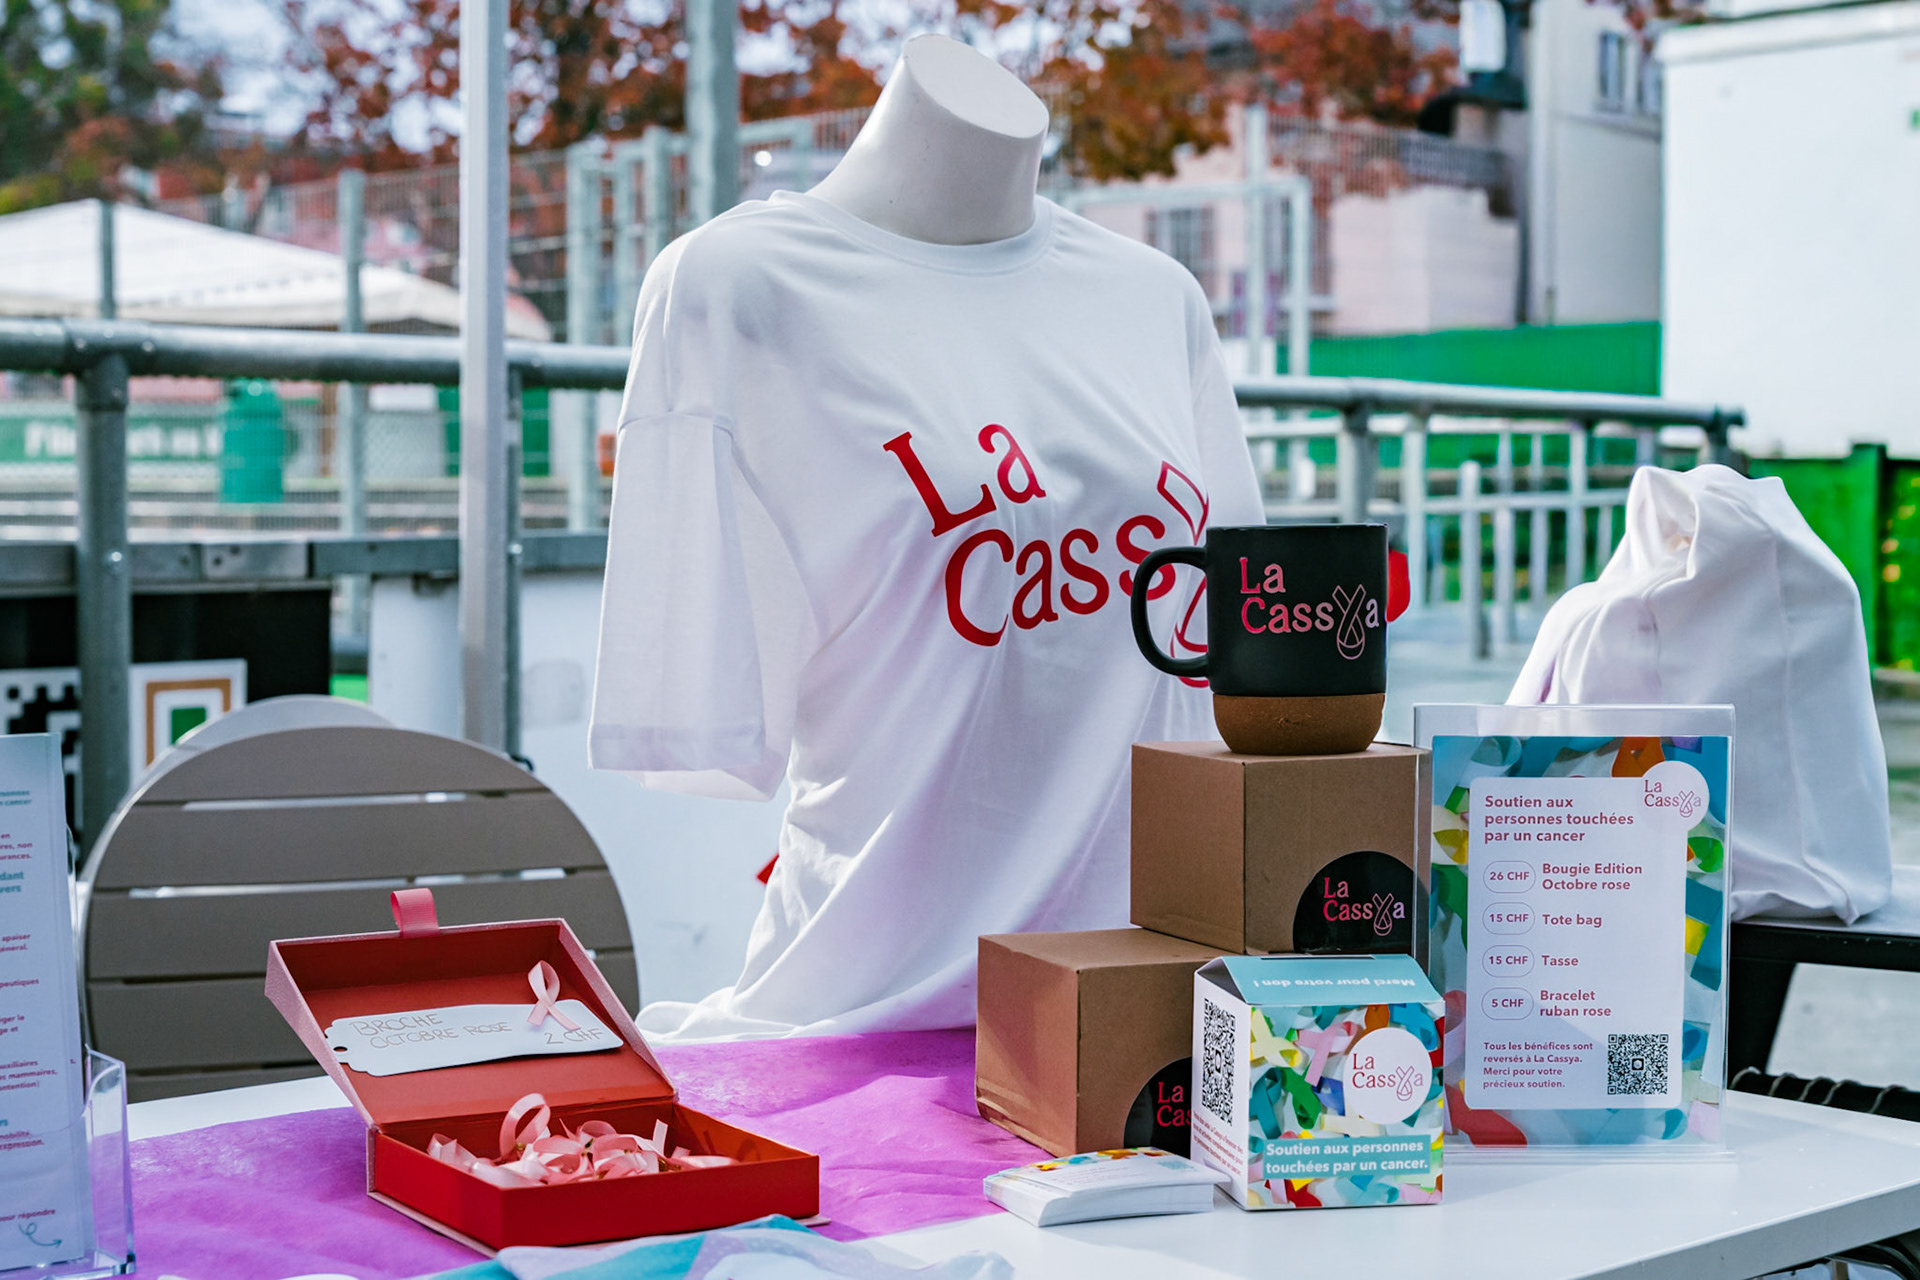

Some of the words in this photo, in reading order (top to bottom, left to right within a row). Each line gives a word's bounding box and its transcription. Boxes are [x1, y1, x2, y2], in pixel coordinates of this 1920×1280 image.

[883, 423, 1046, 537] La
[1239, 556, 1286, 594] La
[1643, 779, 1662, 794] La
[1484, 795, 1542, 808] Soutien
[1546, 798, 1574, 808] aux
[1484, 813, 1563, 827] personnes
[1566, 812, 1634, 825] touchées
[1484, 832, 1510, 844] par
[1514, 832, 1532, 842] un
[1536, 831, 1586, 842] cancer
[1542, 863, 1591, 876] Bougie
[1595, 863, 1642, 875] Edition
[0, 871, 24, 881] dant
[1489, 871, 1504, 881] 26
[1507, 871, 1530, 881] CHF
[1323, 877, 1349, 899] La
[1542, 879, 1598, 890] Octobre
[1602, 880, 1631, 890] rose
[1489, 913, 1503, 923] 15
[1507, 913, 1529, 923] CHF
[1542, 914, 1573, 926] Tote
[1576, 914, 1603, 928] bag
[1489, 956, 1503, 965] 15
[1506, 956, 1529, 966] CHF
[1542, 956, 1579, 967] Tasse
[1262, 979, 1291, 988] don
[1294, 979, 1333, 987] votre
[1337, 978, 1371, 987] pour
[1374, 979, 1416, 988] Merci
[1540, 990, 1596, 1001] Bracelet
[1491, 998, 1499, 1008] 5
[1501, 998, 1524, 1008] CHF
[1540, 1006, 1579, 1017] ruban
[1583, 1007, 1612, 1017] rose
[349, 1013, 444, 1036] BROCHE
[370, 1027, 459, 1049] OCTOBRE
[464, 1021, 512, 1036] ROSE
[544, 1032, 563, 1045] 2
[563, 1028, 604, 1043] CHF
[1484, 1042, 1505, 1050] Tous
[1508, 1042, 1522, 1050] les
[1524, 1041, 1569, 1051] bénéfices
[1572, 1042, 1593, 1051] sont
[1352, 1052, 1375, 1070] La
[1484, 1054, 1522, 1063] reversés
[1525, 1054, 1531, 1063] à
[1534, 1054, 1544, 1063] La
[1547, 1054, 1583, 1064] Cassya.
[1483, 1067, 1509, 1076] Merci
[1512, 1069, 1534, 1078] pour
[1537, 1067, 1563, 1076] votre
[1483, 1079, 1525, 1090] précieux
[1527, 1079, 1566, 1089] soutien.
[1157, 1081, 1184, 1103] La
[1156, 1105, 1192, 1127] Cas
[1266, 1142, 1320, 1157] Soutien
[1323, 1144, 1350, 1156] aux
[1352, 1141, 1424, 1158] personnes
[1265, 1158, 1329, 1174] touchées
[1332, 1161, 1357, 1177] par
[1359, 1161, 1379, 1173] un
[1381, 1159, 1428, 1171] cancer.
